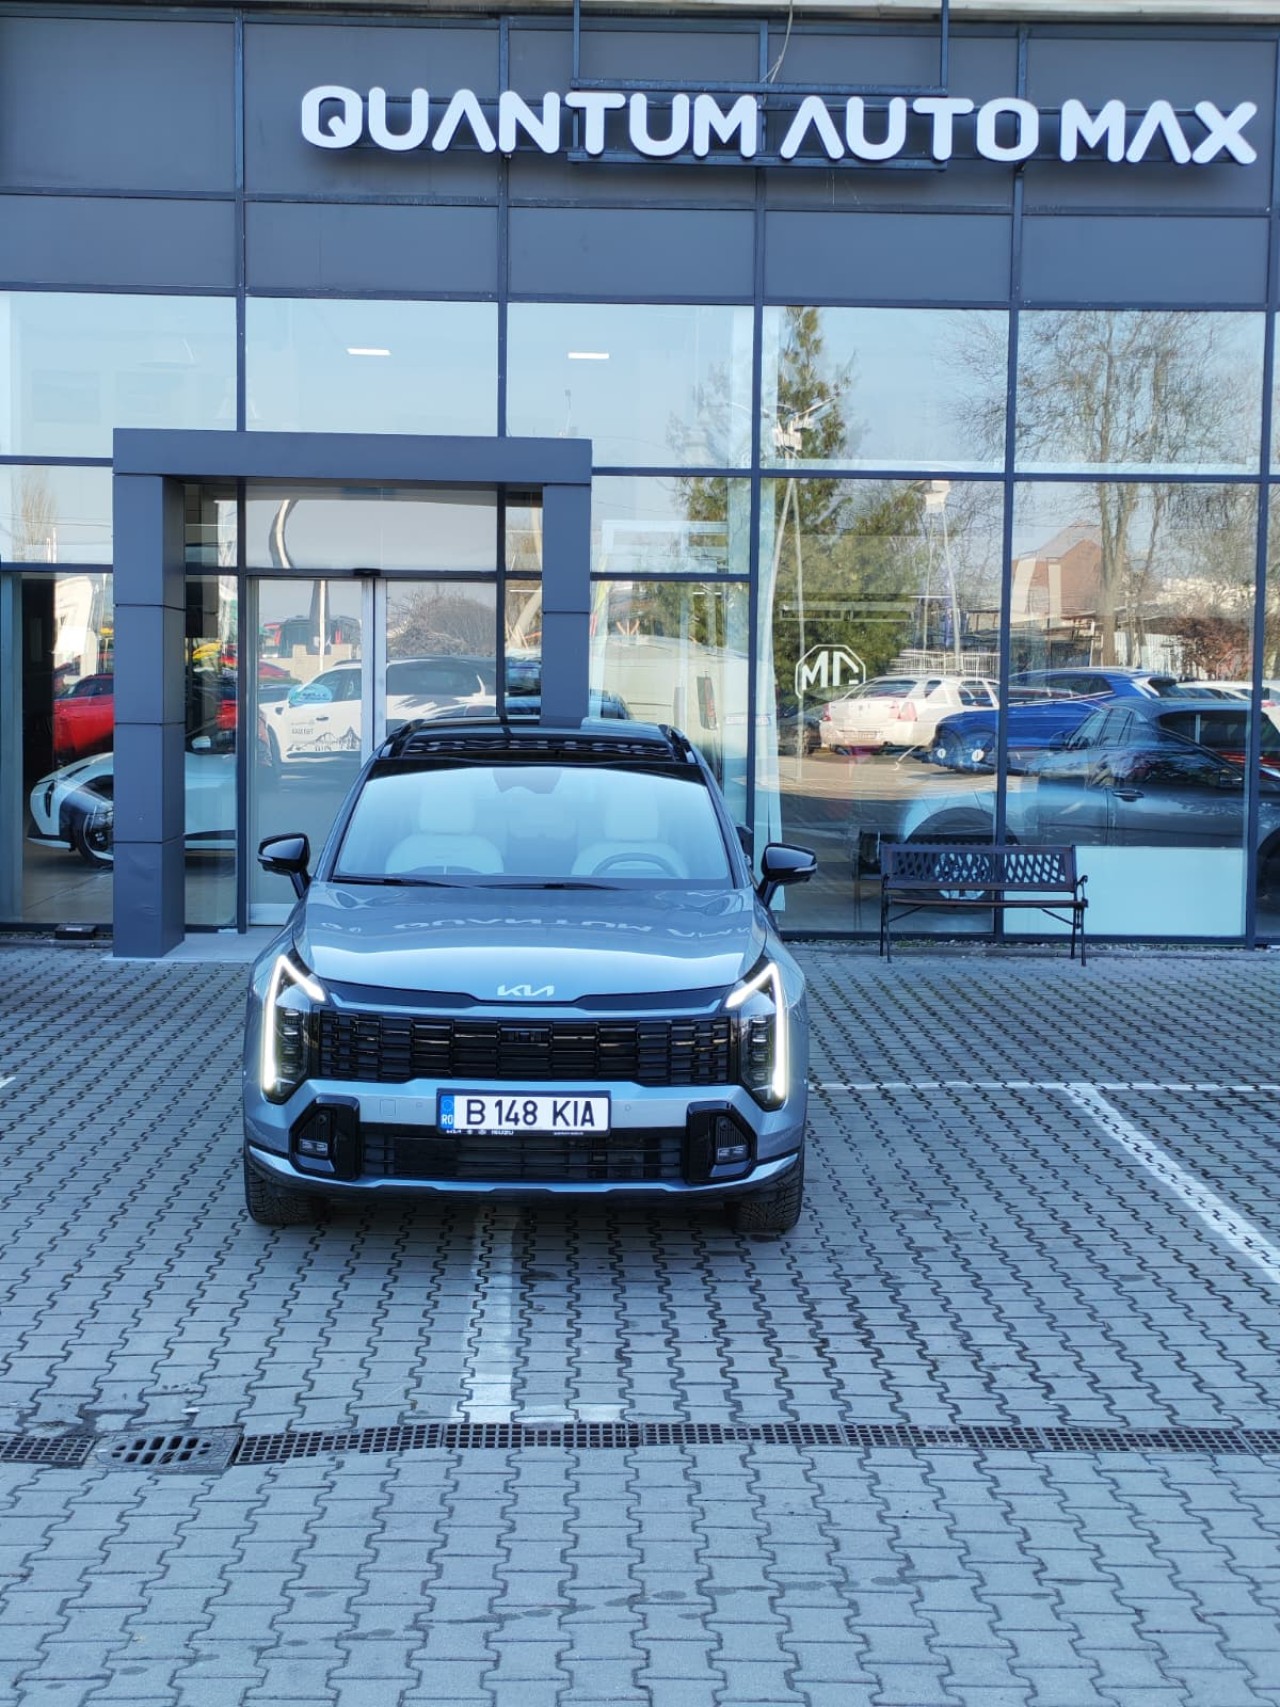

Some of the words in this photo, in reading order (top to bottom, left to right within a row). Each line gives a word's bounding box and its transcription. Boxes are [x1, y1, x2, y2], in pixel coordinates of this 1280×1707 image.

[301, 85, 758, 158] QUANTUM
[780, 95, 1040, 163] AUTO
[1059, 98, 1259, 165] MAX
[800, 649, 861, 692] MG
[497, 984, 555, 997] KIA
[441, 1114, 454, 1125] RO
[466, 1099, 486, 1126] B
[494, 1100, 538, 1126] 148
[552, 1100, 595, 1127] KIA
